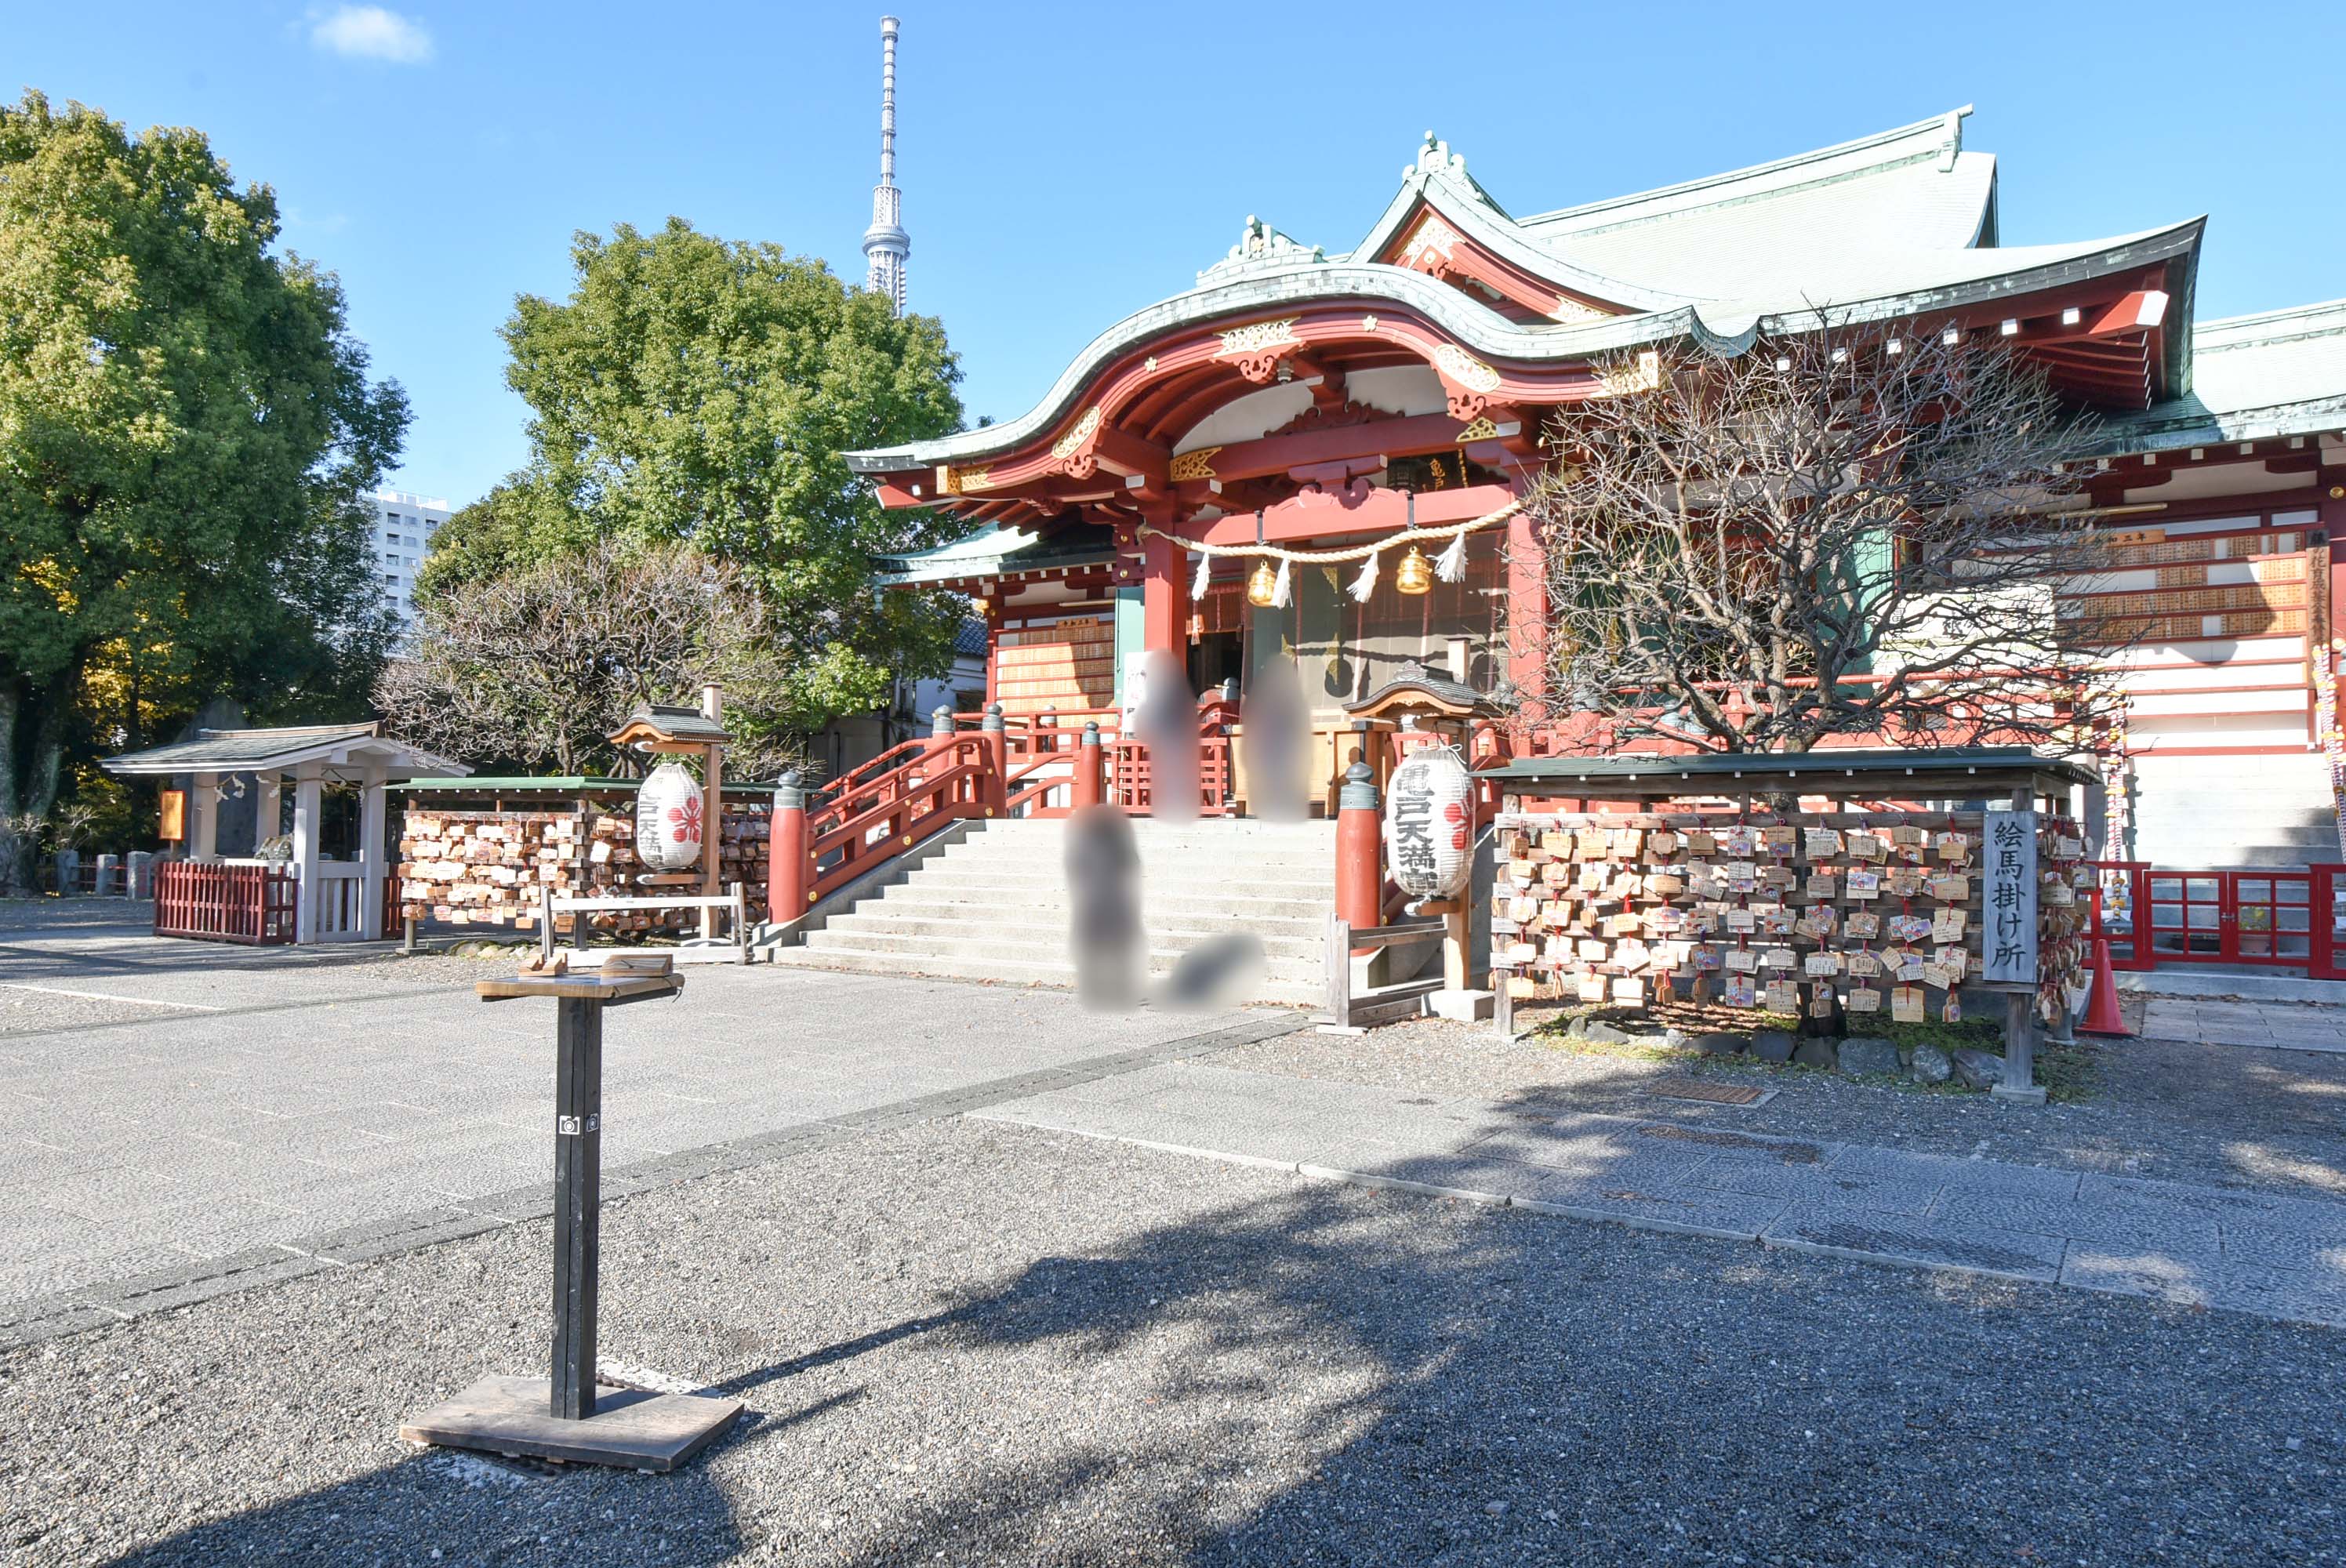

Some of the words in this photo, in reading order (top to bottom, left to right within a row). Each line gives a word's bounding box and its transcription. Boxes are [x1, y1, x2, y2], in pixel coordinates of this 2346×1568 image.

[1992, 821, 2027, 971] 絵馬掛け所
